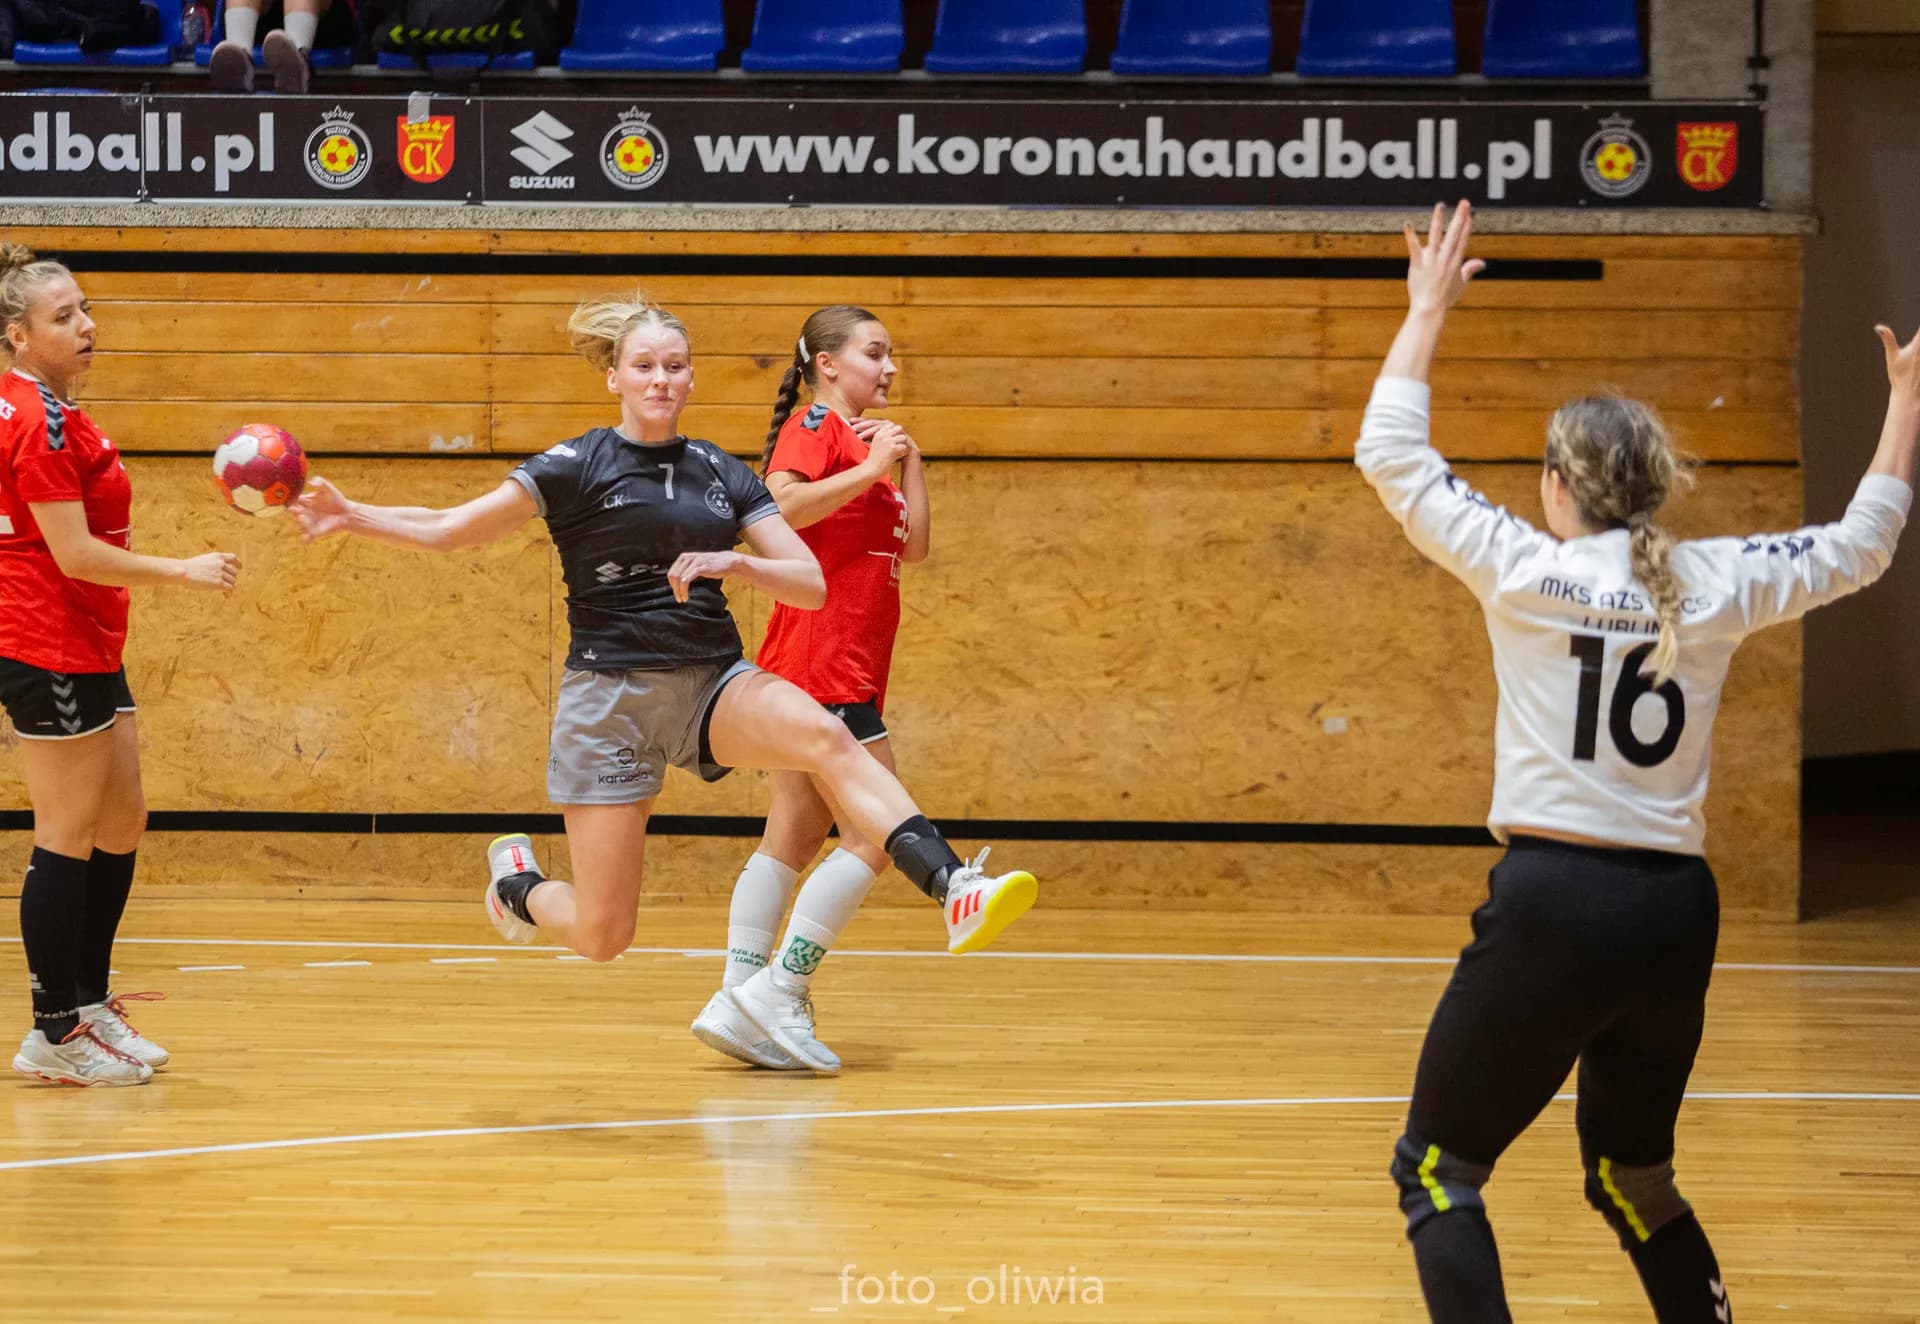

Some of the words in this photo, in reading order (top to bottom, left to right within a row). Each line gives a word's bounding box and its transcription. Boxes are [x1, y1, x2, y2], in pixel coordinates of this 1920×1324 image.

[0, 111, 274, 192] dball.pl
[403, 141, 444, 176] CK
[694, 113, 1551, 199] www.koronahandball.pl
[1682, 149, 1726, 184] CK
[509, 175, 575, 189] SUZUKI
[658, 463, 675, 500] 7
[1539, 576, 1591, 605] MKS
[1600, 591, 1644, 612] AZS
[1569, 633, 1685, 769] 16
